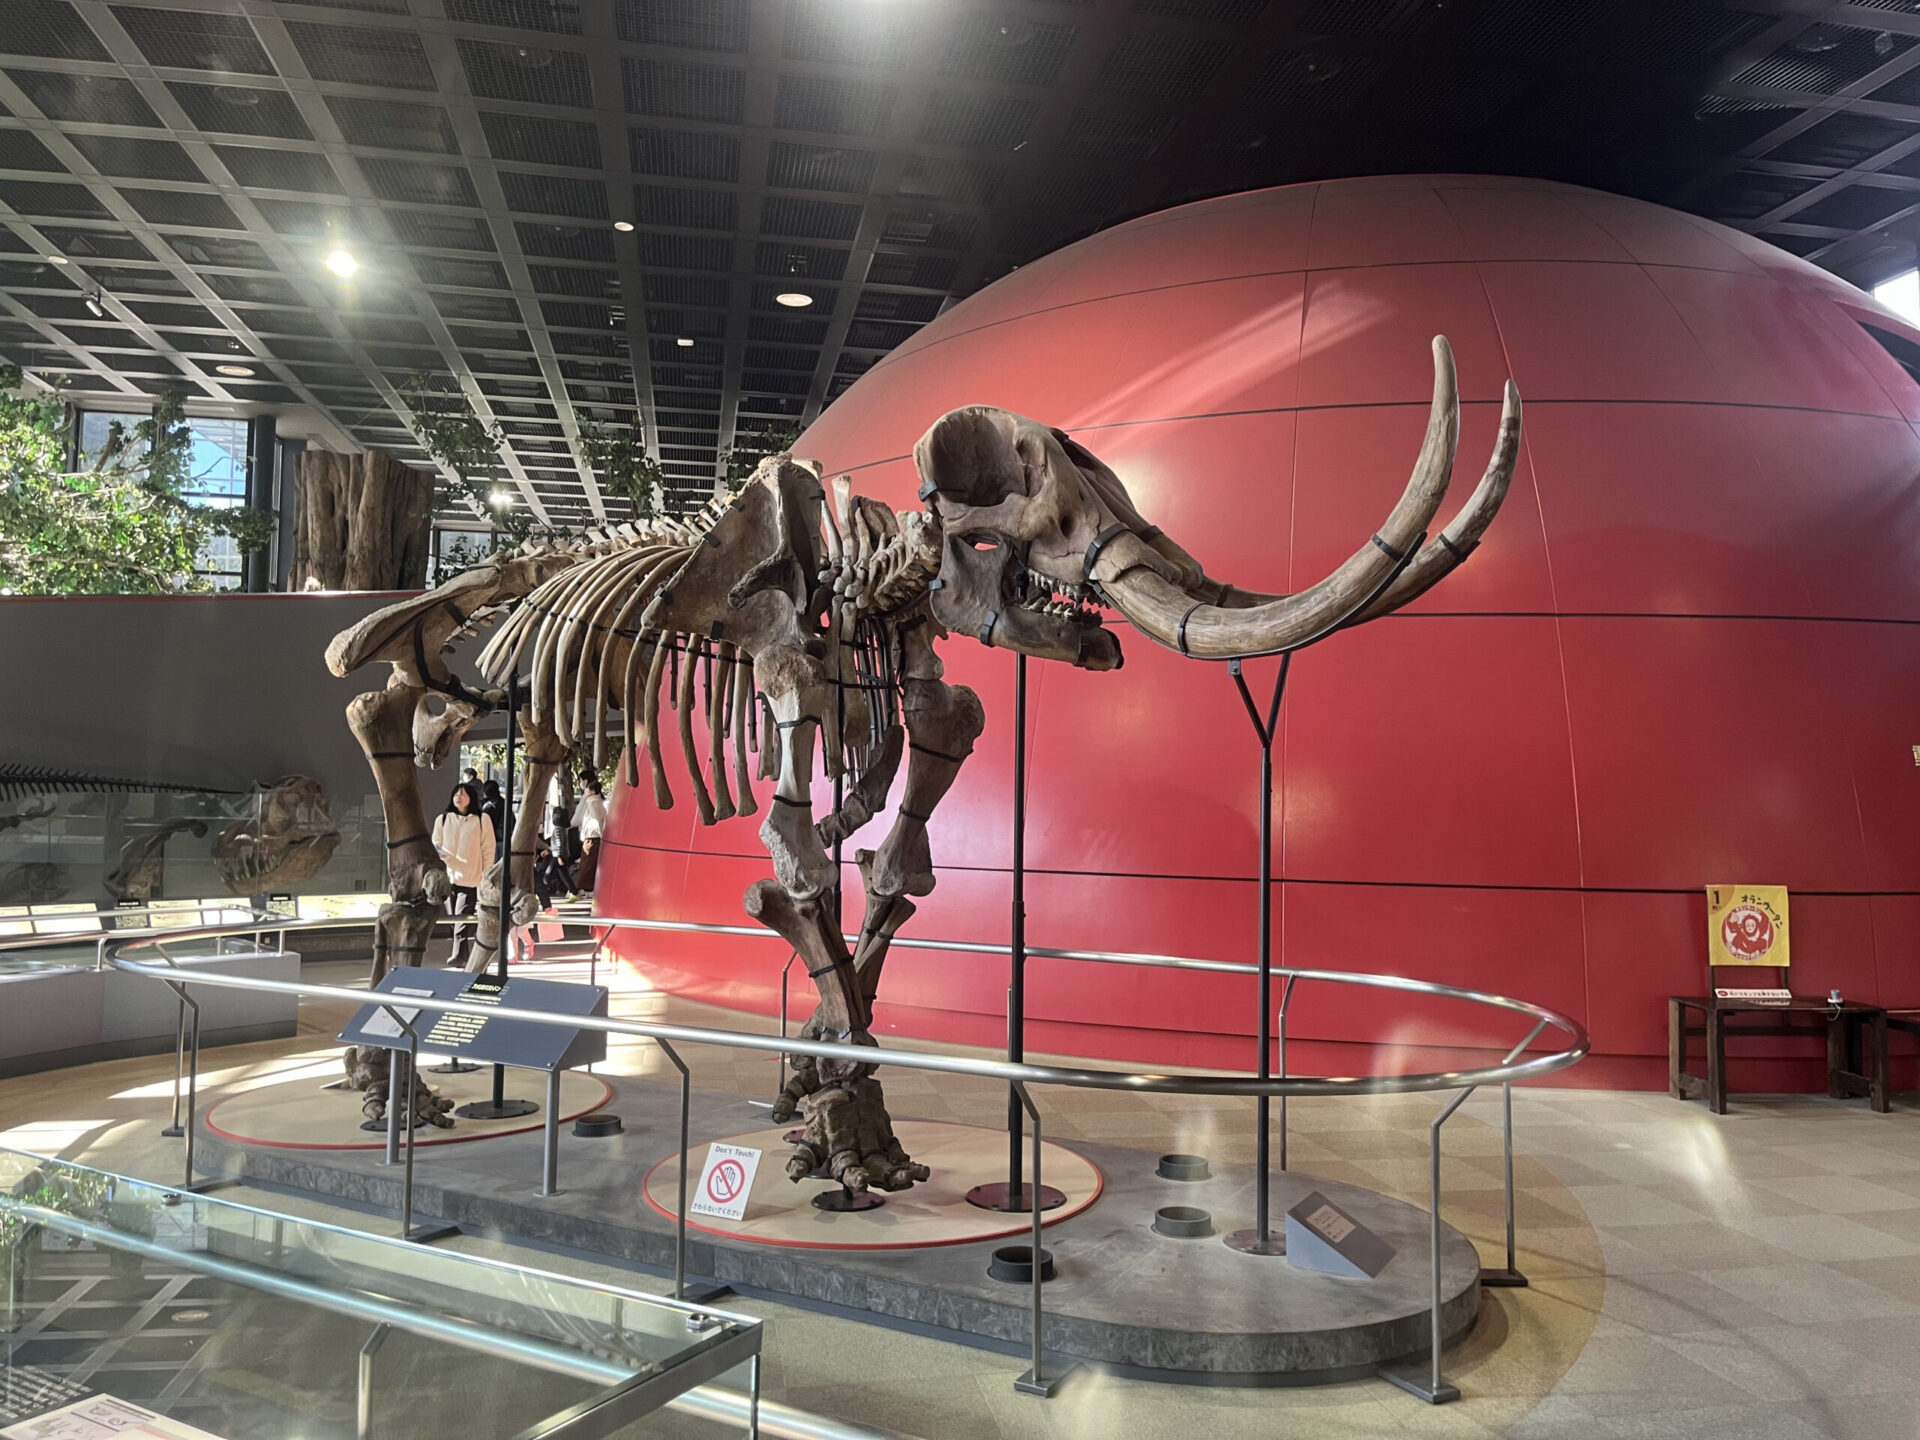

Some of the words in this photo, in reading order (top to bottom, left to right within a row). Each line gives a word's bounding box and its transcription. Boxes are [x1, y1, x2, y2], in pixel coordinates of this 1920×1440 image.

[715, 1145, 732, 1154] Don't
[735, 1149, 754, 1158] Touch!
[693, 1203, 741, 1216] さわらないでください
